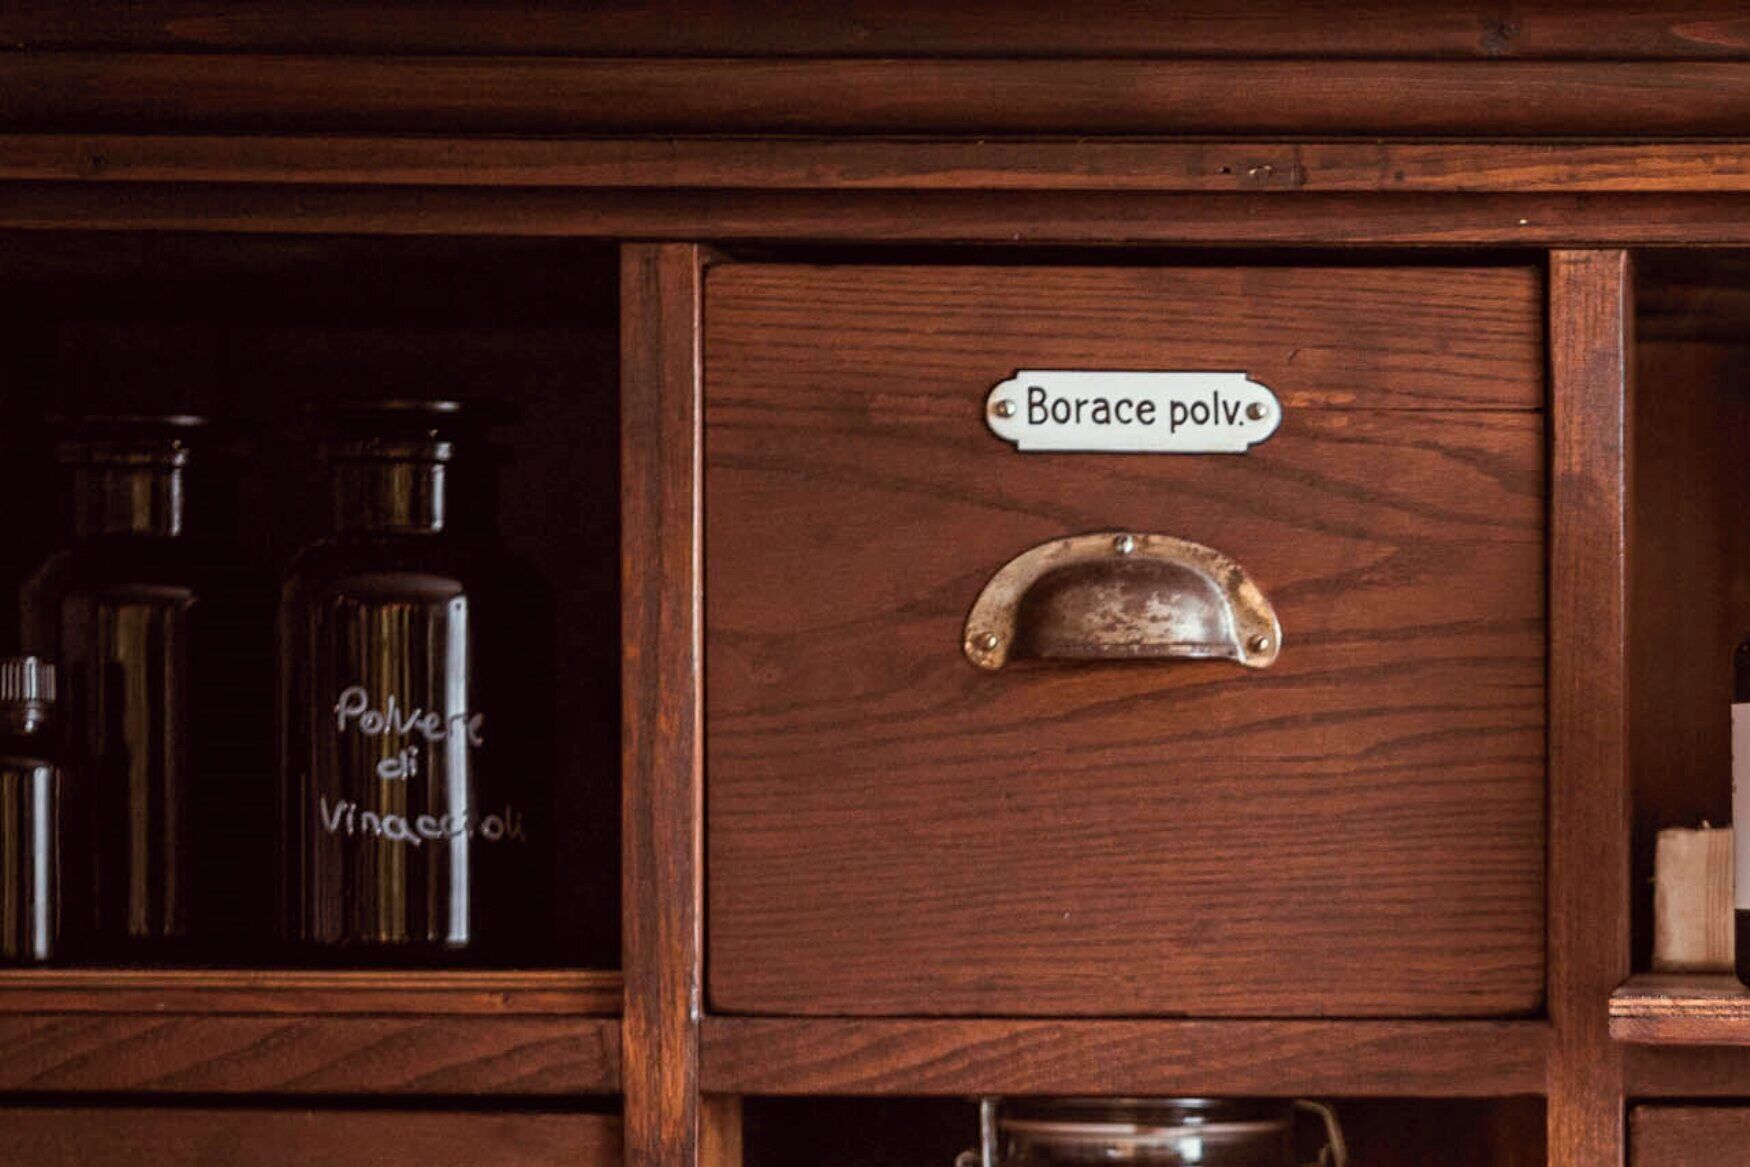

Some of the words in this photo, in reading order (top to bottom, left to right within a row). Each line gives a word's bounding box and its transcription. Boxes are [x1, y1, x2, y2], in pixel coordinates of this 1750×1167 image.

[1027, 386, 1156, 426] Borace
[1170, 390, 1244, 433] polv.
[376, 745, 419, 780] di
